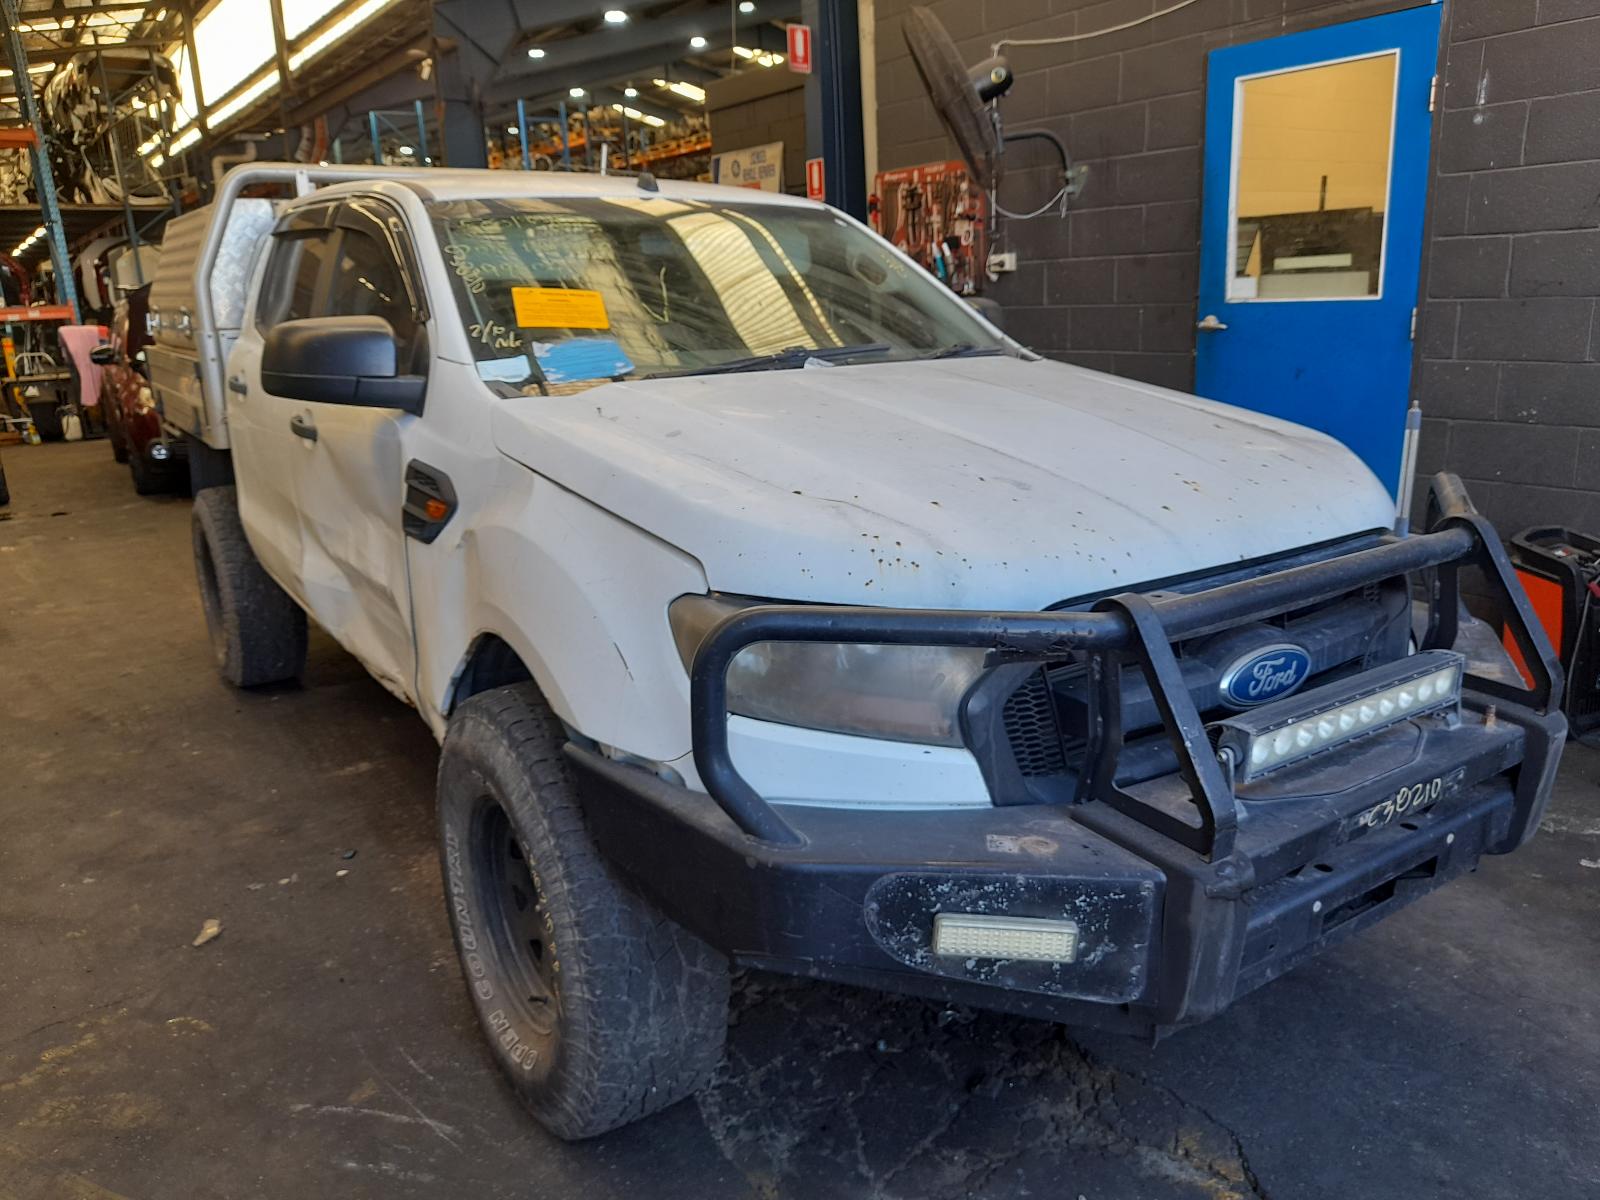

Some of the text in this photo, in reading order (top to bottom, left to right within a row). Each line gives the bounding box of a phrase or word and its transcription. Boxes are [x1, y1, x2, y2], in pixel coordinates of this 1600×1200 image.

[1248, 657, 1297, 697] Ford
[1367, 778, 1441, 827] C30210
[488, 1008, 538, 1070] OPEN
